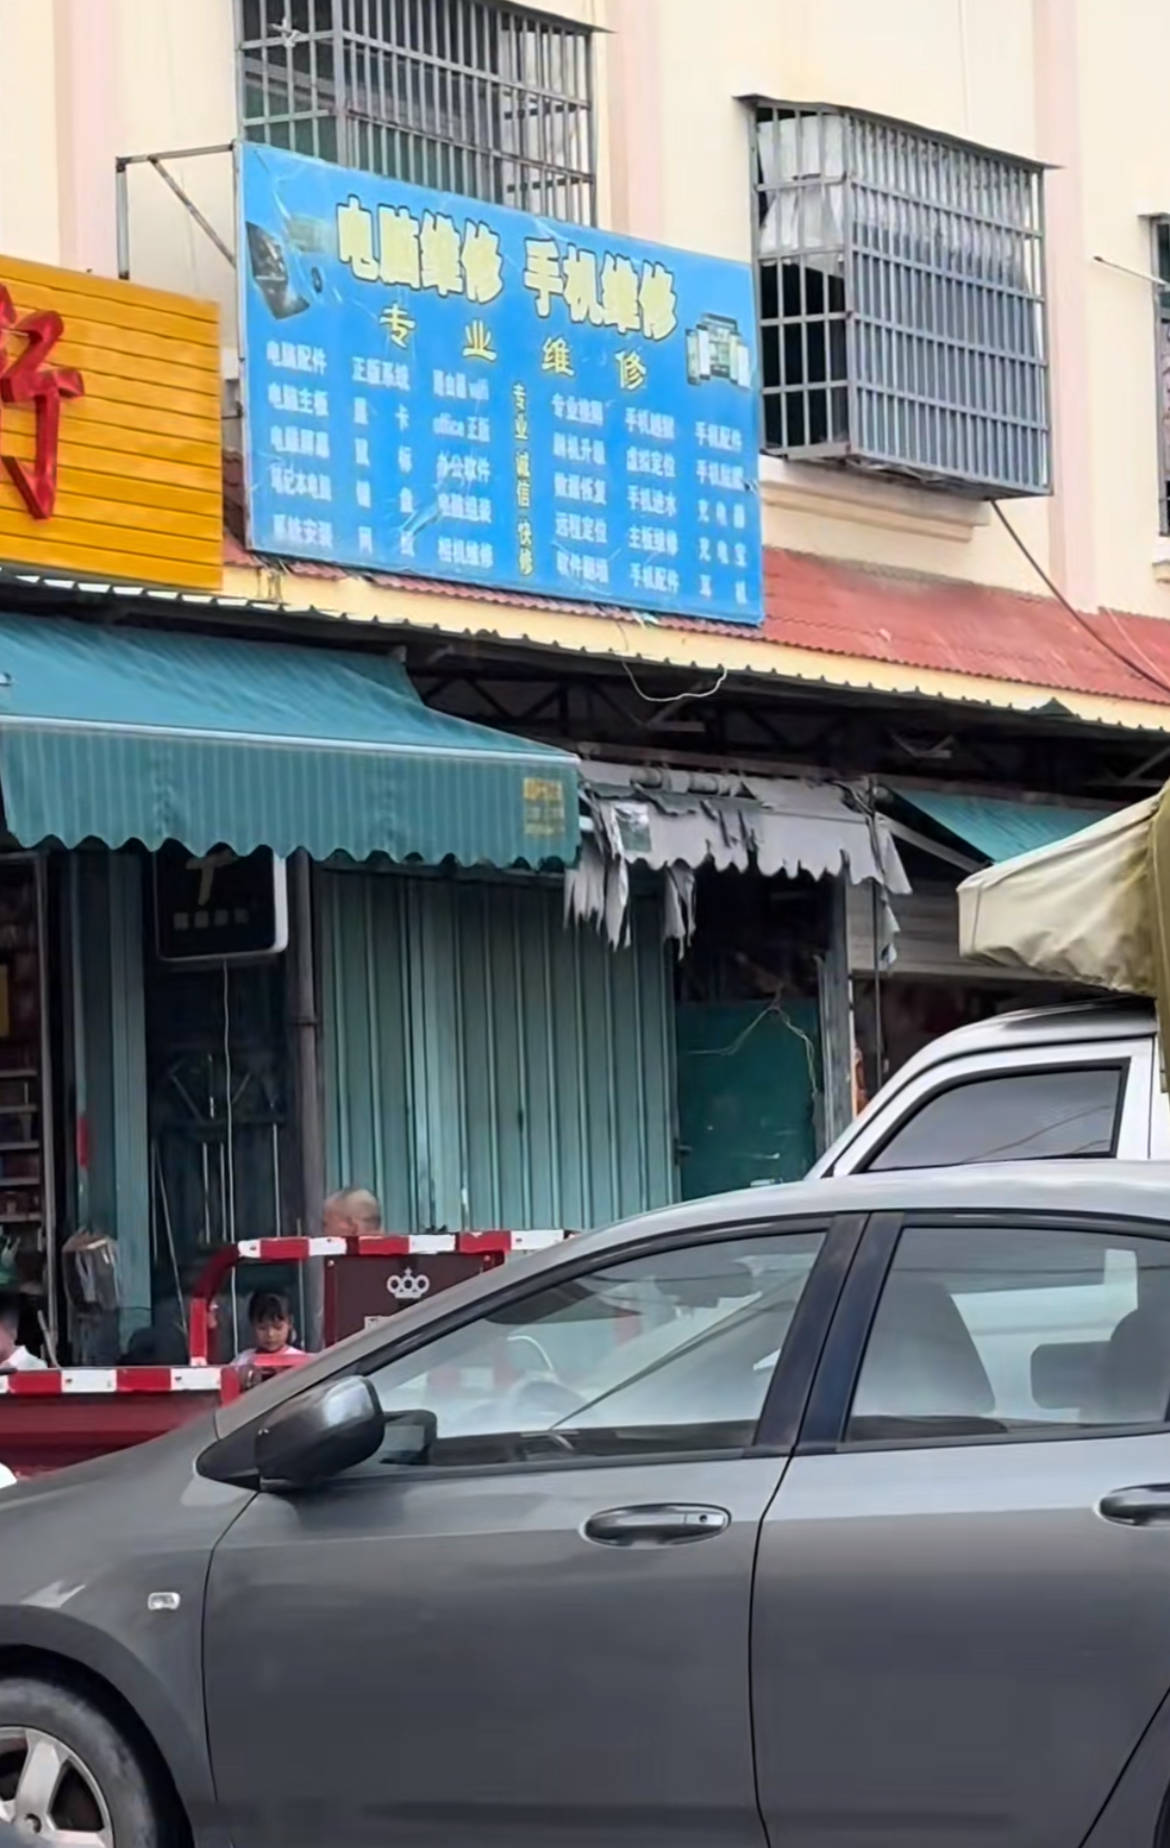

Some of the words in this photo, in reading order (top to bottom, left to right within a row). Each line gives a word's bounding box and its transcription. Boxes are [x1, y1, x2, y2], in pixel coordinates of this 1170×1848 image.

[337, 194, 503, 304] 电脑维修
[524, 235, 678, 341] 手机维修
